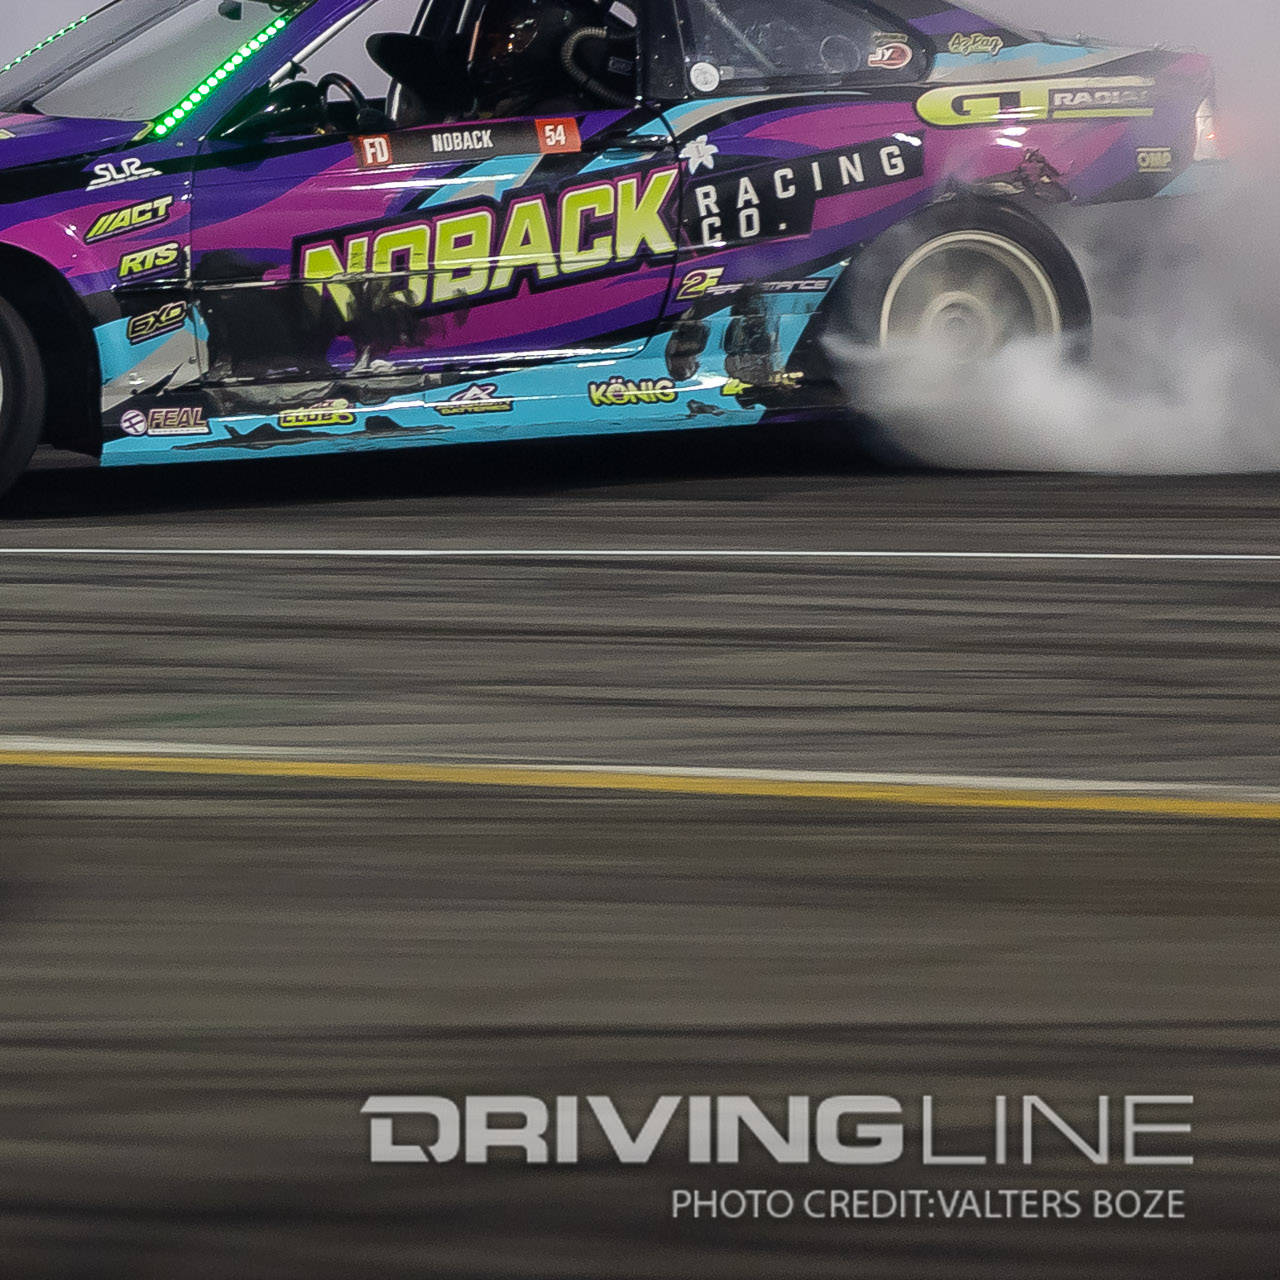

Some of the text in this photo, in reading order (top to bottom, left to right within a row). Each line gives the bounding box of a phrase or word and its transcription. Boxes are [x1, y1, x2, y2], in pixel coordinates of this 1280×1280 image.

[916, 78, 1080, 125] GT
[363, 123, 567, 164] FD NOBACK 54
[89, 157, 156, 187] SLR
[695, 144, 905, 217] RACING
[304, 166, 678, 322] NOBACK
[702, 207, 788, 246] CO.
[119, 242, 178, 277] RTS
[590, 377, 675, 405] KÖNIG
[148, 408, 207, 429] FEAL
